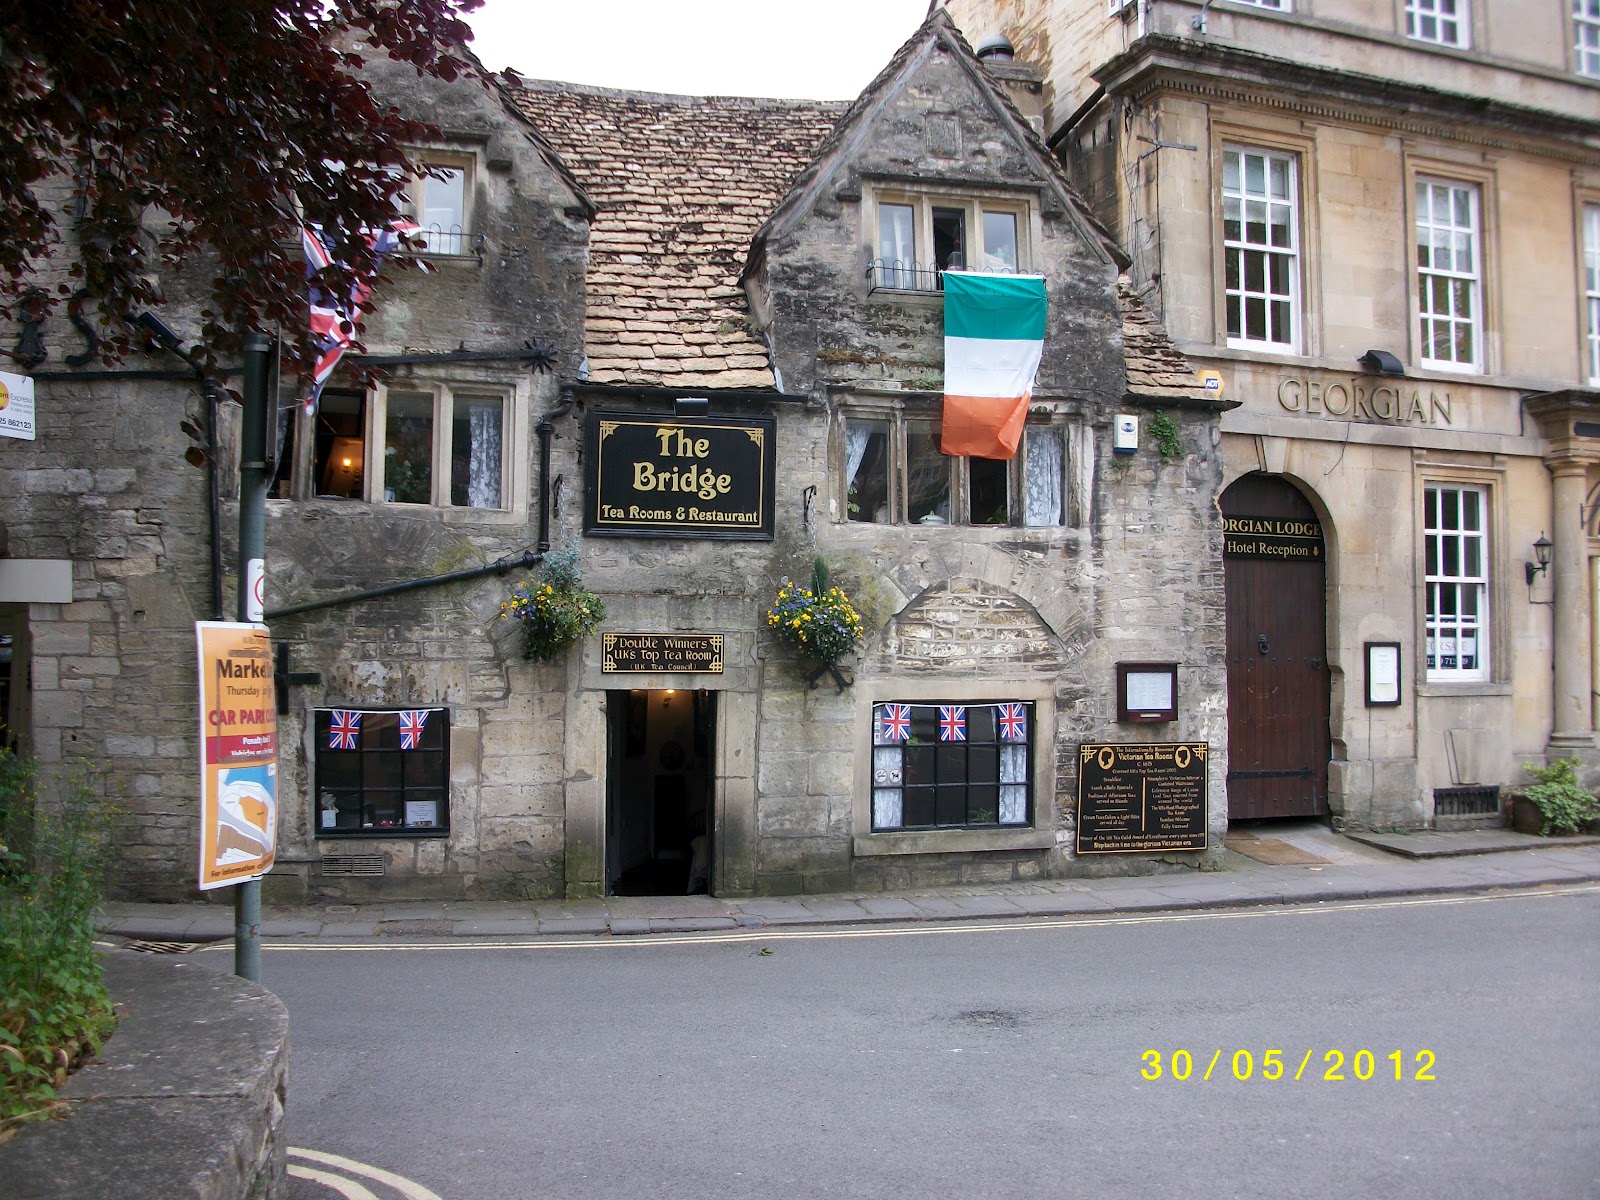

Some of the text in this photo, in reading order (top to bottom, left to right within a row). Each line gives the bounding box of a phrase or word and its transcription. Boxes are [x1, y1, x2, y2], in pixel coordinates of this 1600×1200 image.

[1206, 380, 1218, 388] ADT
[1278, 378, 1453, 425] GEORGIAN
[656, 428, 710, 458] The
[632, 462, 732, 500] Bridge
[602, 505, 758, 523] Tea Rooms & Restaurant
[1222, 518, 1321, 536] ORGIAN LODGE
[1227, 541, 1308, 558] Hotel Reception
[620, 636, 708, 649] Double Winners
[1446, 641, 1468, 651] SAE
[614, 649, 712, 663] UK's Top Tea Room
[668, 662, 697, 671] Council)
[226, 685, 260, 697] Thursday
[208, 709, 236, 726] CAR
[1118, 752, 1143, 760] Victorian
[222, 864, 255, 876] information
